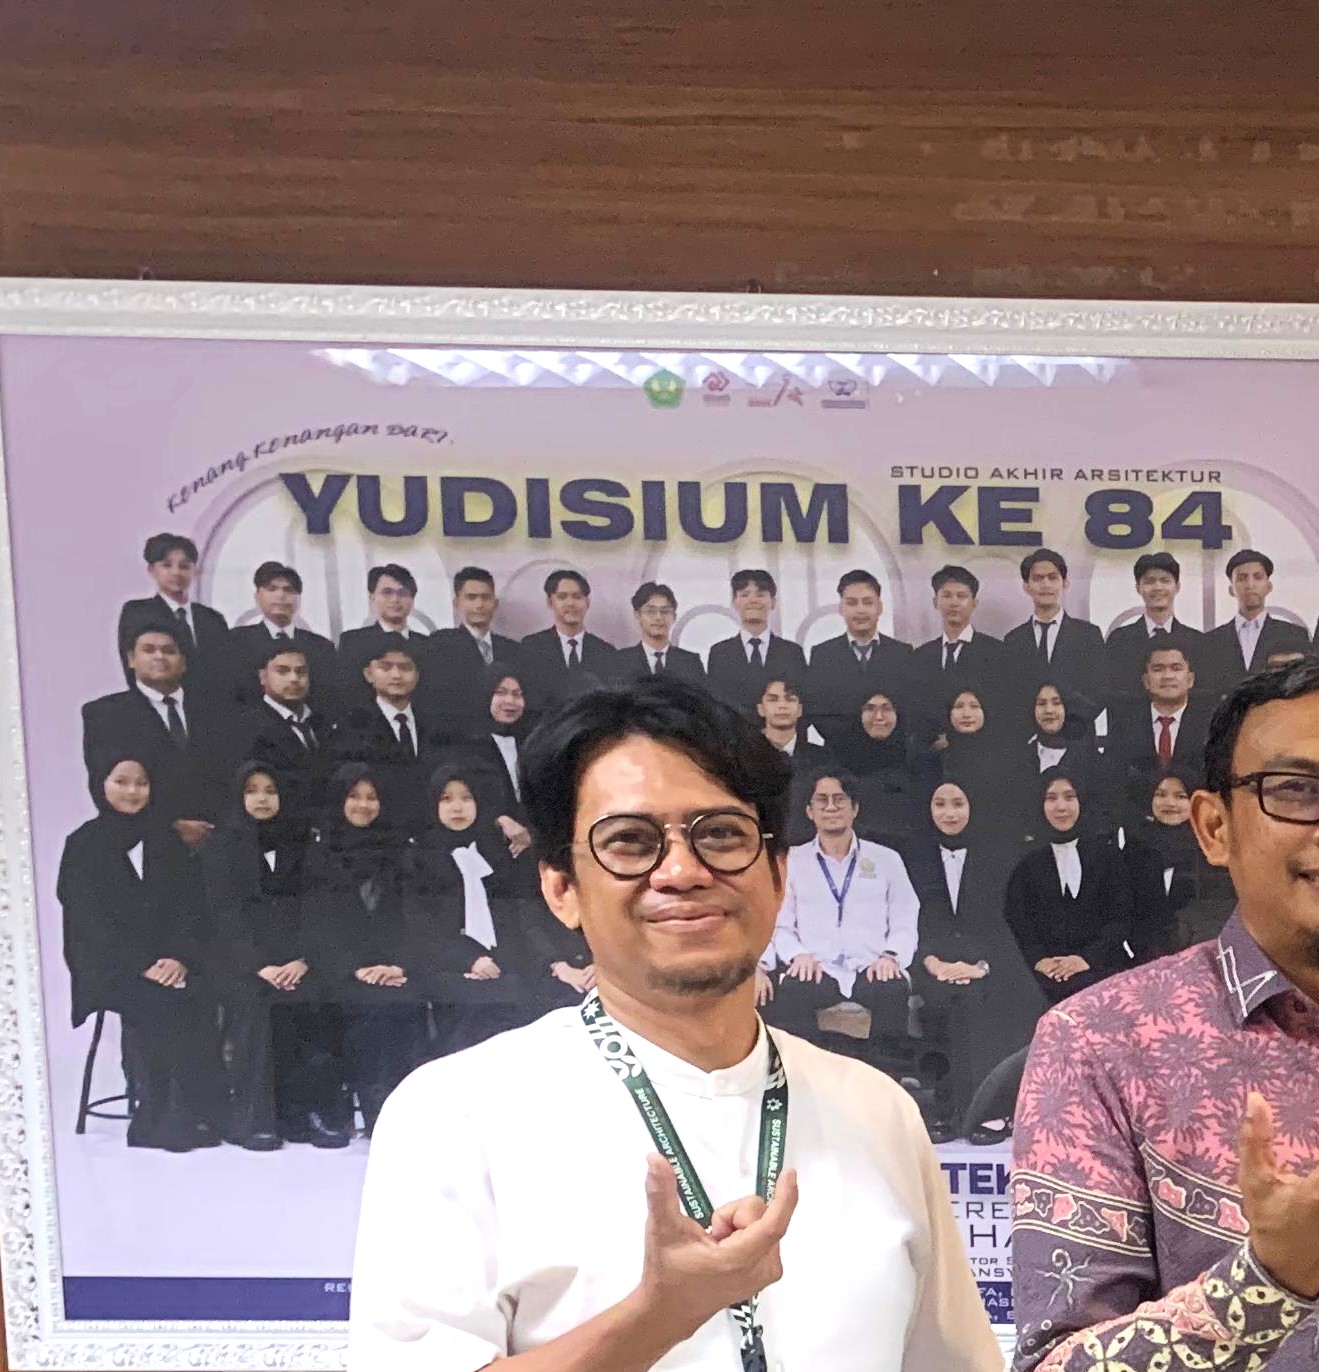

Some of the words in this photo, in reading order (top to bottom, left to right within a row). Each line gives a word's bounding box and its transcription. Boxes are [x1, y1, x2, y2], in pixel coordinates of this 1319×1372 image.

[890, 466, 979, 479] STUDIO
[989, 467, 1064, 481] AKHIR
[1073, 468, 1222, 484] ARSITEKTUR
[279, 472, 850, 544] YUDISIUM
[898, 484, 1043, 546] KE
[1084, 489, 1233, 550] 84
[635, 1087, 675, 1156] ARCHITECTURE
[768, 1119, 781, 1180] SUSTAINABLE
[669, 1157, 704, 1220] SUSTAINABLE
